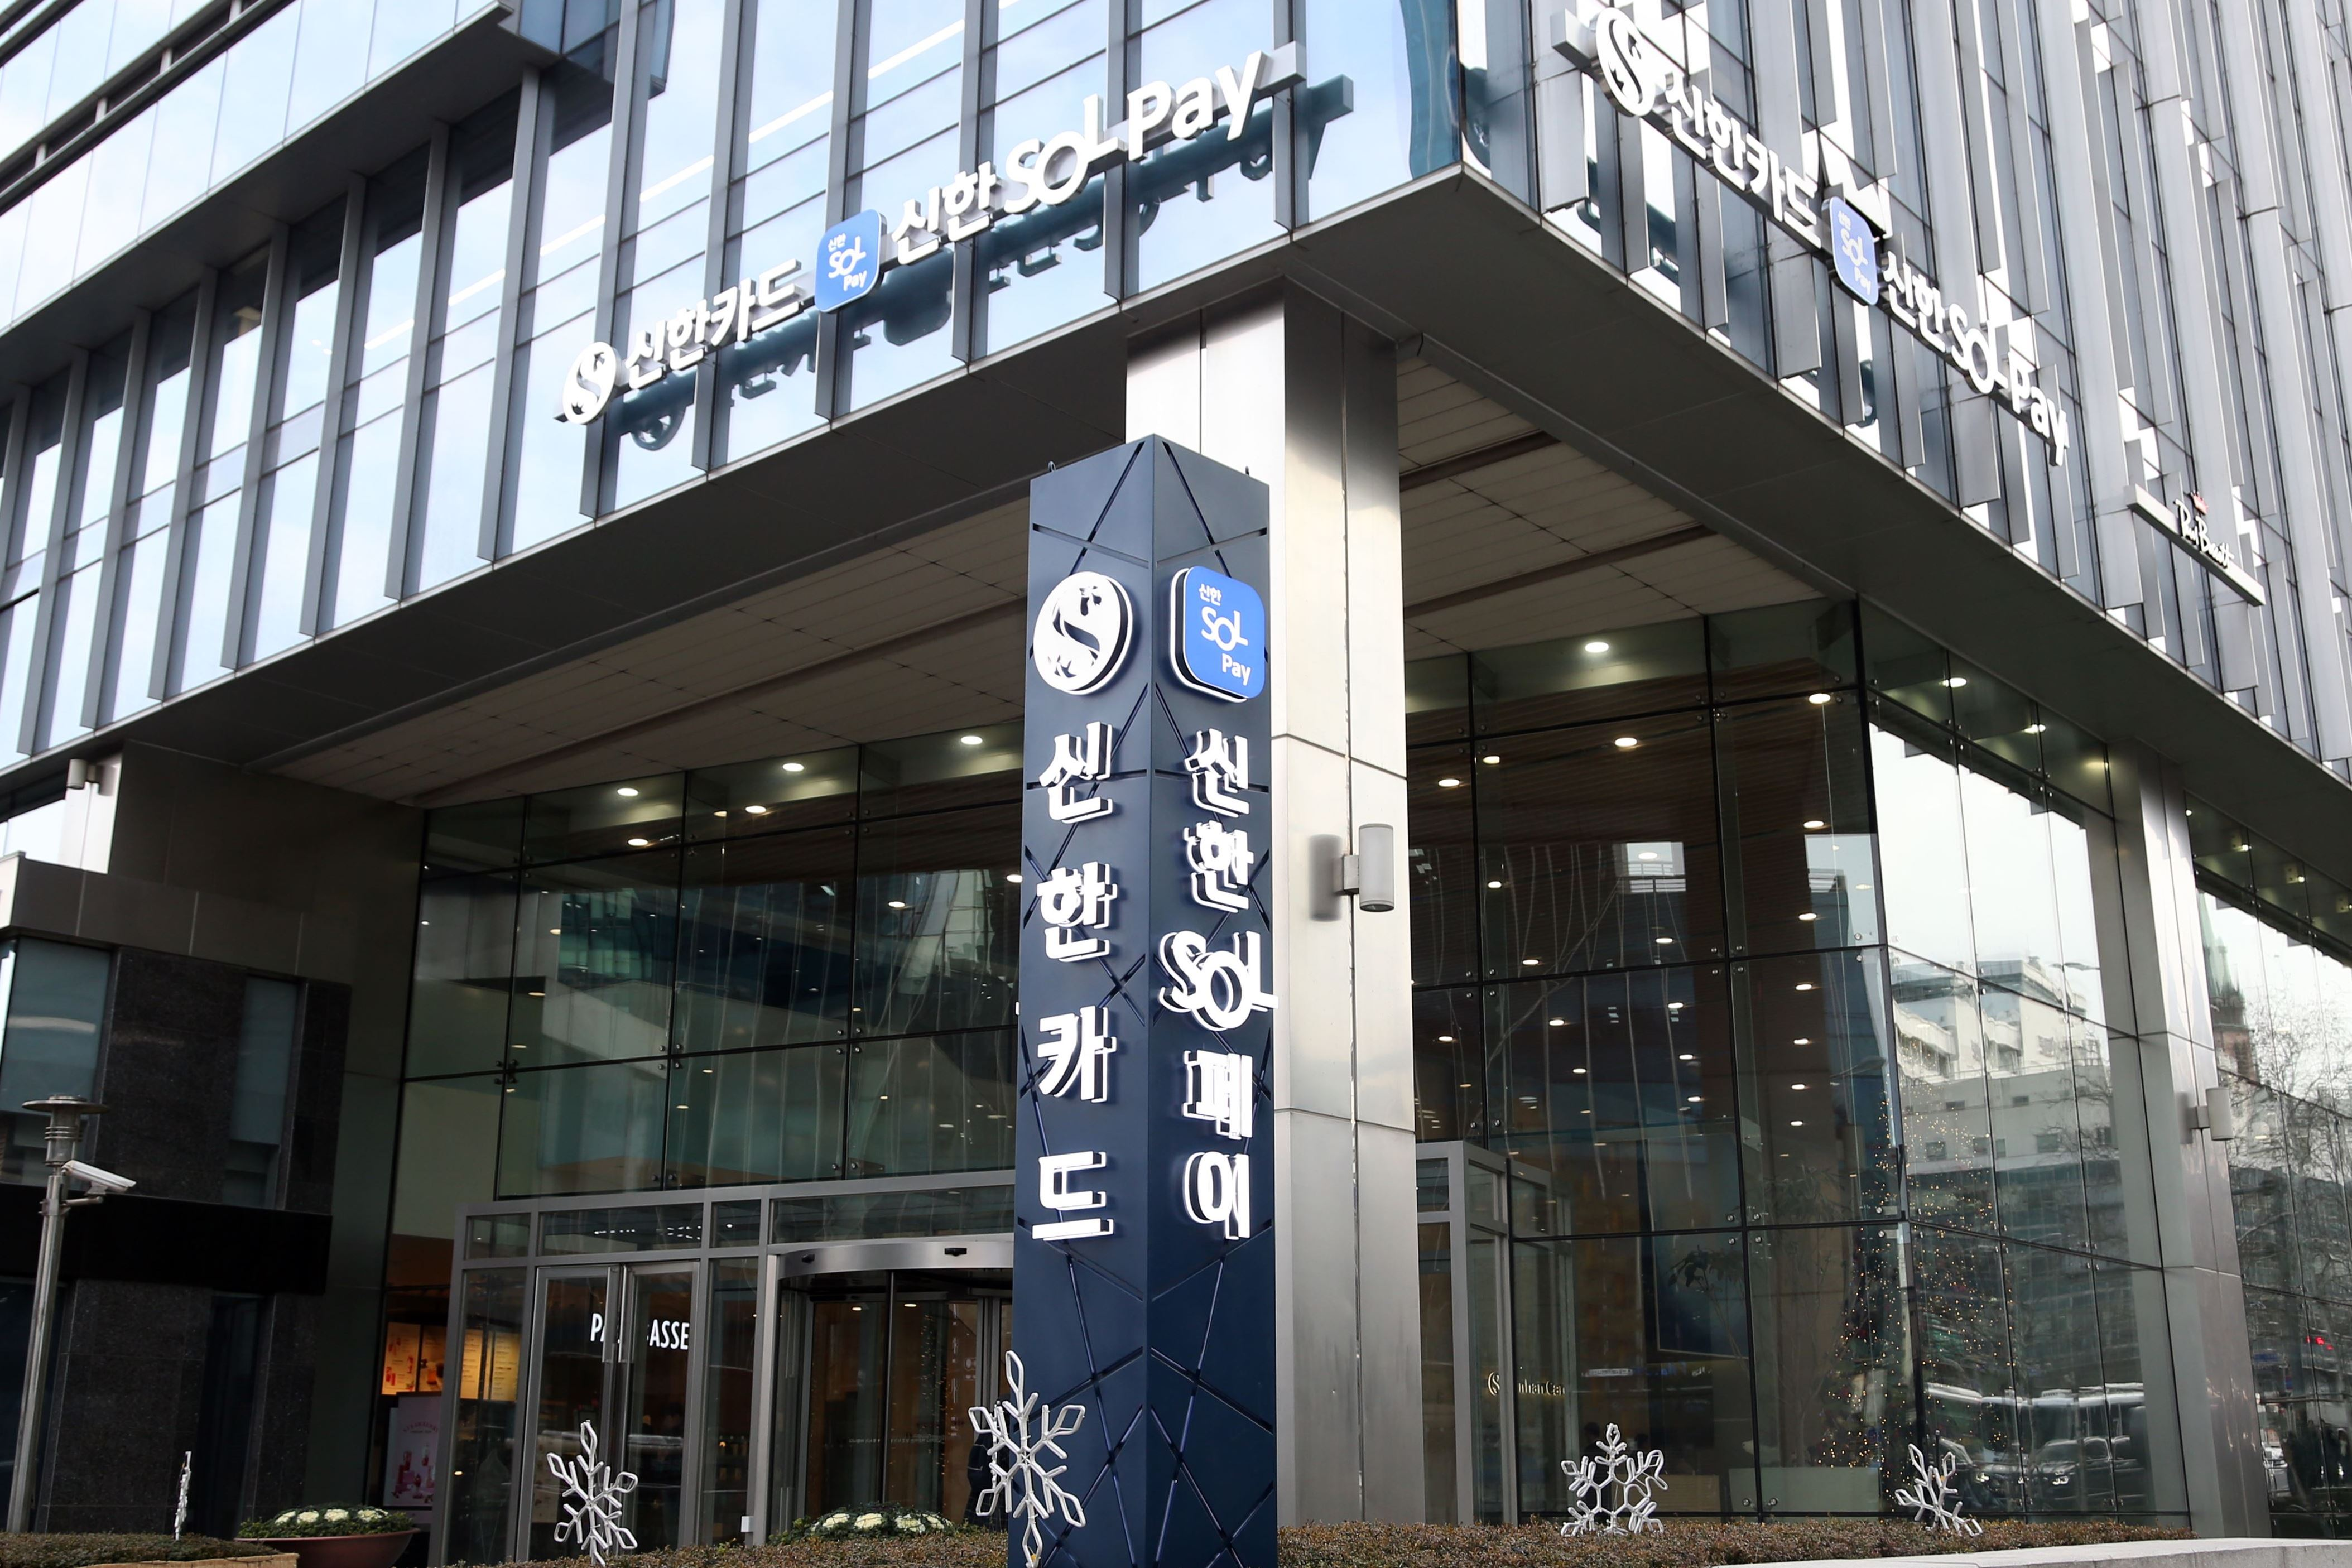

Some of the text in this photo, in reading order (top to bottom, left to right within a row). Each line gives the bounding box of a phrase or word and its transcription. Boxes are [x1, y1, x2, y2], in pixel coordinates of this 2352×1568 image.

[1665, 68, 1821, 249] 신한카드
[828, 233, 846, 252] 신한
[828, 235, 867, 278] SOL
[1840, 228, 1868, 266] SOL
[843, 270, 868, 291] Pay
[1854, 266, 1872, 296] Pay
[625, 258, 800, 389] 신한카드
[1198, 583, 1222, 607] 신한
[1201, 606, 1249, 652] SOL
[1221, 652, 1252, 686] Pay
[1032, 721, 1117, 1240] 신한카드
